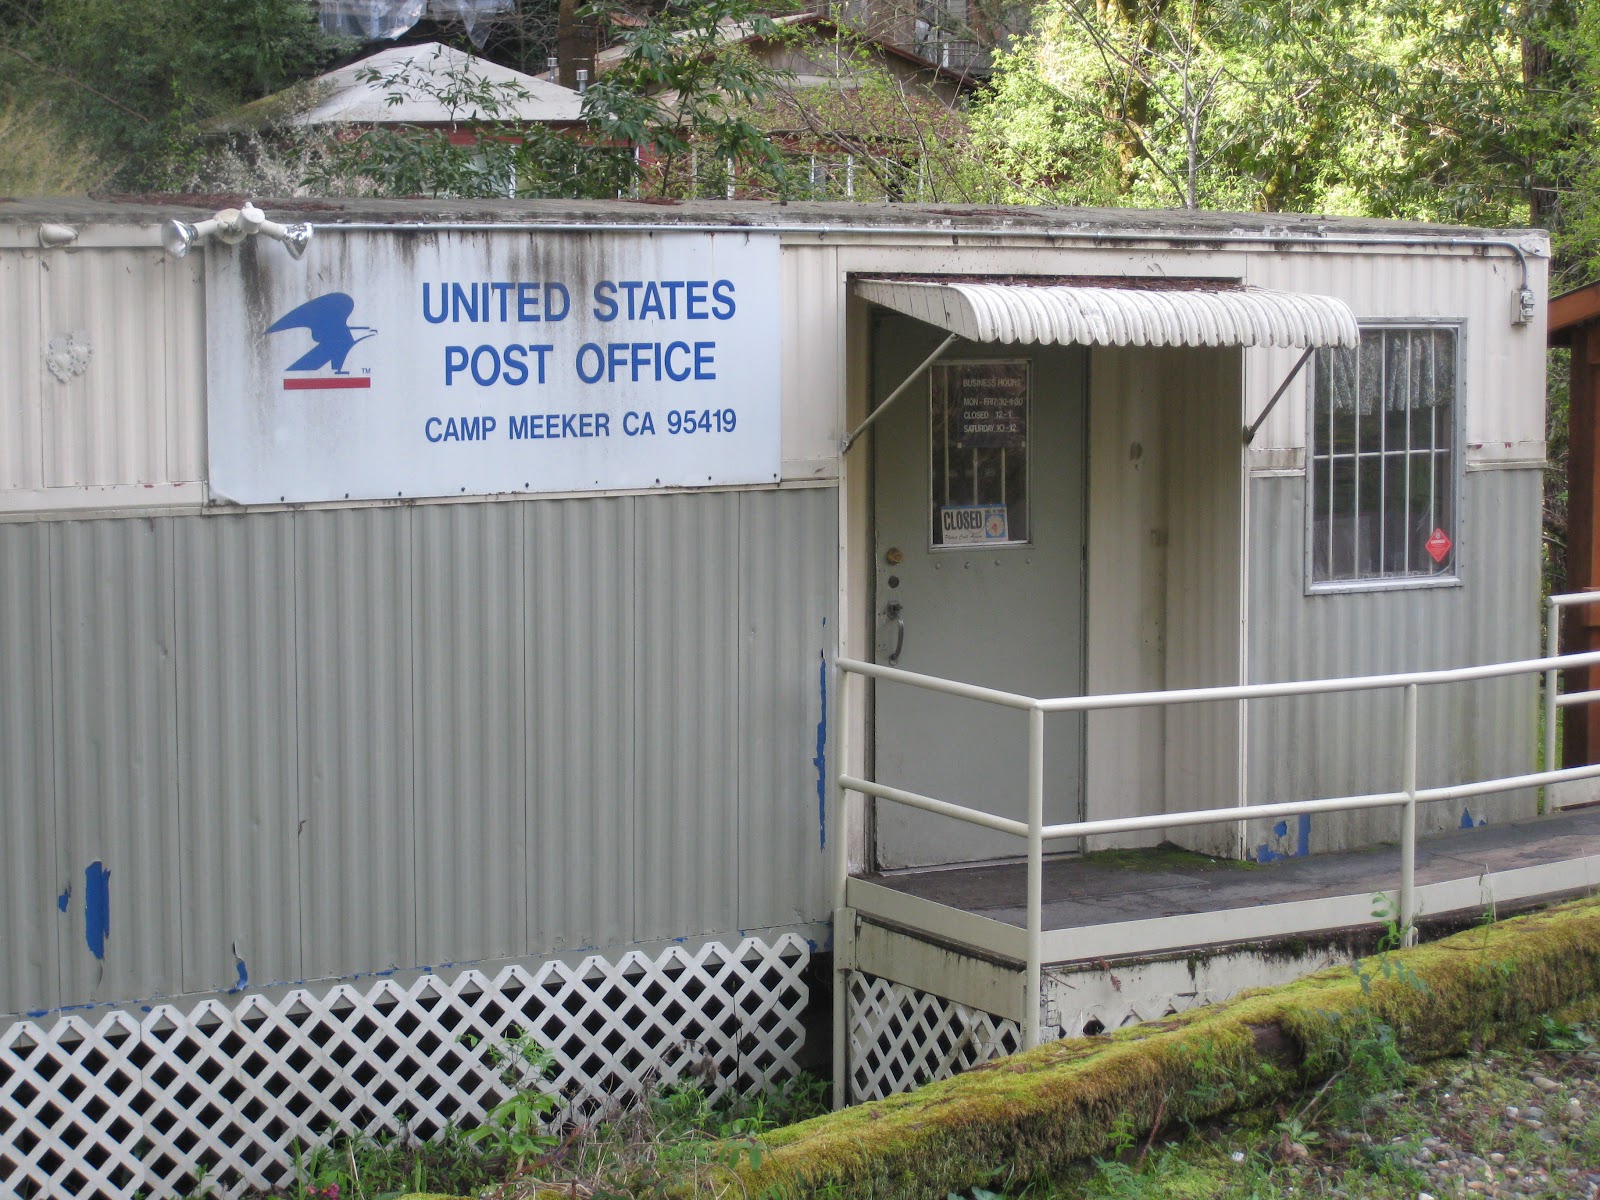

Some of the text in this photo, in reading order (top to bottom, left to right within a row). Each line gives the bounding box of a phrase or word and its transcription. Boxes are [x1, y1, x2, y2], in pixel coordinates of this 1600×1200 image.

[423, 279, 736, 323] UNITED STATES
[444, 341, 717, 387] POST OFFICE
[963, 378, 1021, 387] BUSINESS HOURS
[963, 397, 978, 406] MON
[963, 410, 989, 419] CLOSED
[425, 408, 736, 443] CAMP MEEKER CA 95419
[963, 424, 994, 433] SATURDAY
[943, 510, 983, 531] CLOSED
